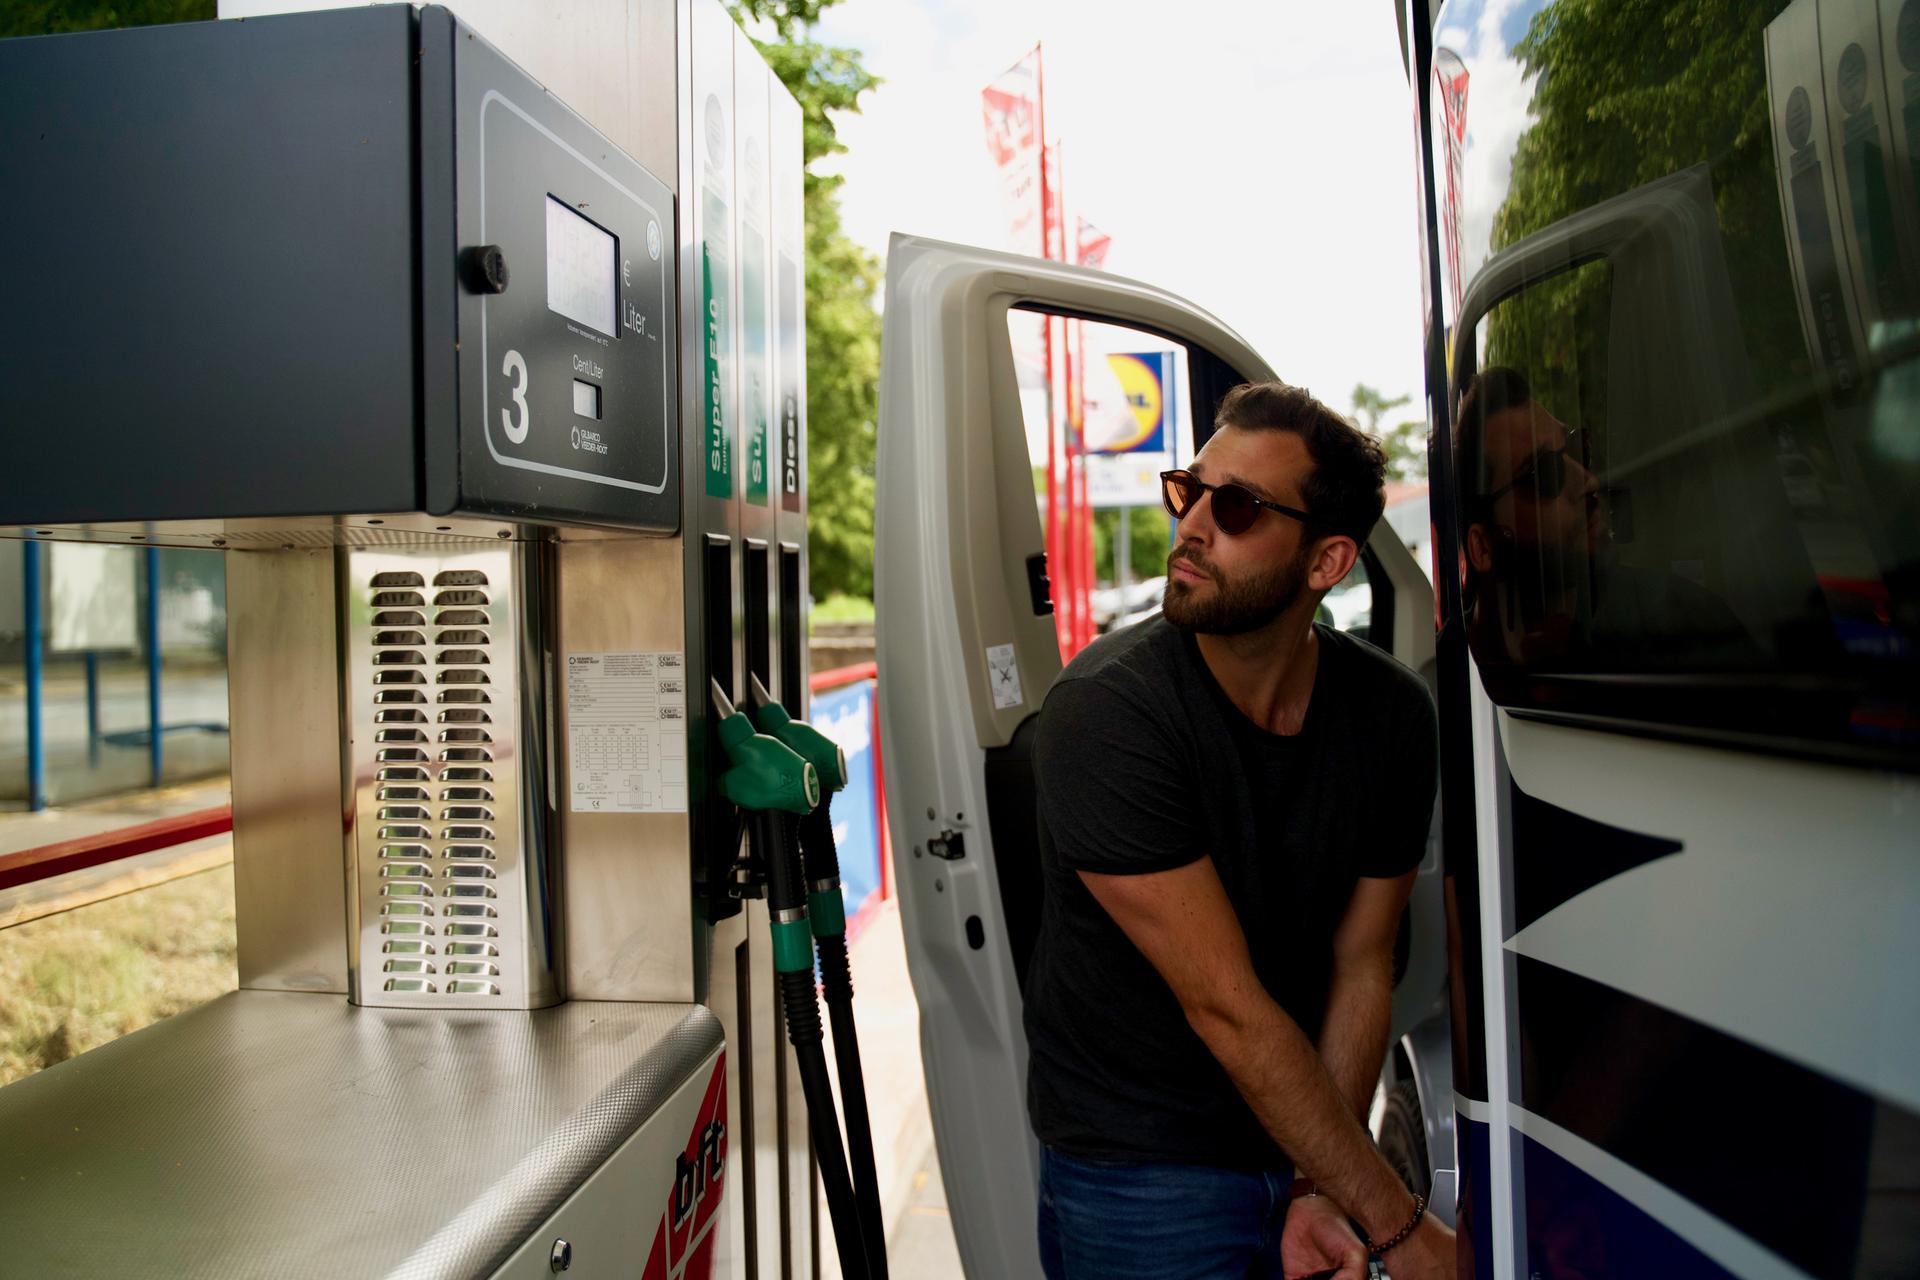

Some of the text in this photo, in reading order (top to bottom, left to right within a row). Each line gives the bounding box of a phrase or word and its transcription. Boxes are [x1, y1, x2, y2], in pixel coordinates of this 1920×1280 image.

[623, 259, 632, 288] €
[623, 299, 647, 336] Liter
[502, 349, 529, 445] 3
[572, 353, 605, 379] Cent/Liter
[709, 299, 723, 472] Super E10
[786, 393, 796, 494] Diese
[674, 1119, 726, 1233] bft
